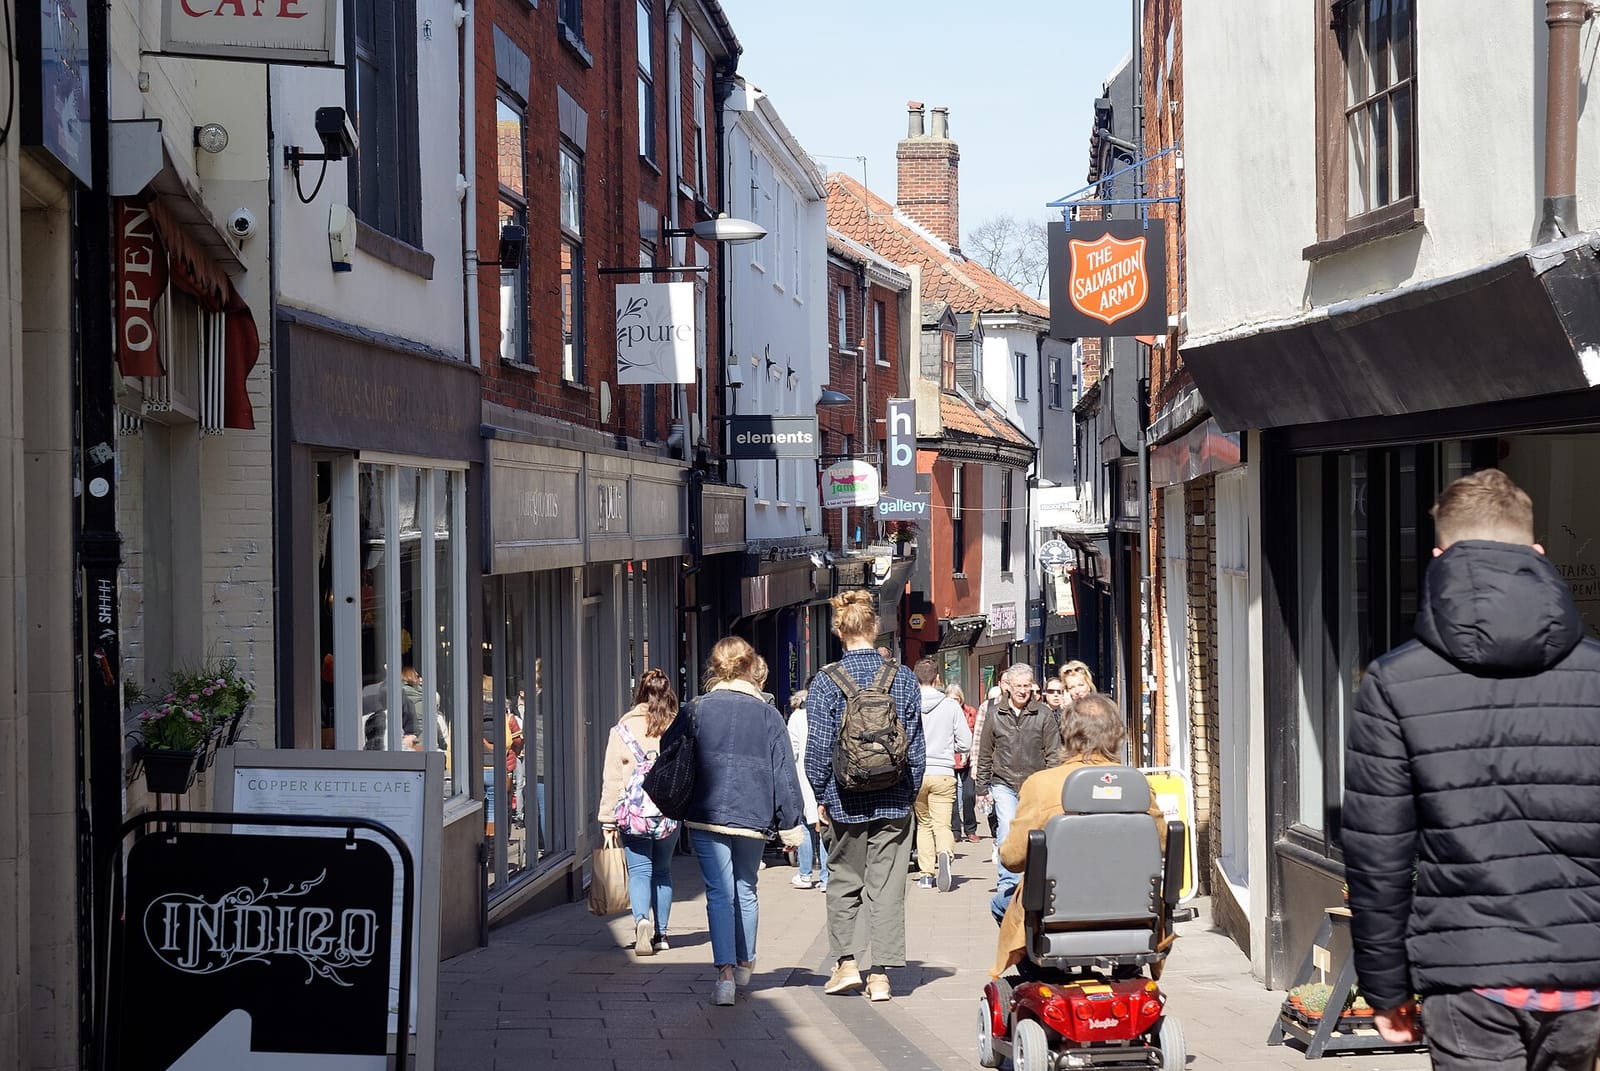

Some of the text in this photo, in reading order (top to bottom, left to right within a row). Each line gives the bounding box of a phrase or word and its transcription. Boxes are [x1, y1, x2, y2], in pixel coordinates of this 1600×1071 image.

[1086, 245, 1113, 271] THE
[124, 202, 154, 352] OPEN
[1075, 250, 1140, 300] SALVATION
[1100, 276, 1137, 311] ARMY
[627, 322, 692, 347] pure
[736, 430, 813, 444] elements
[879, 499, 925, 514] gallery
[247, 779, 308, 792] COPPER
[314, 780, 367, 792] KETTLE
[146, 893, 379, 973] INDIGO
